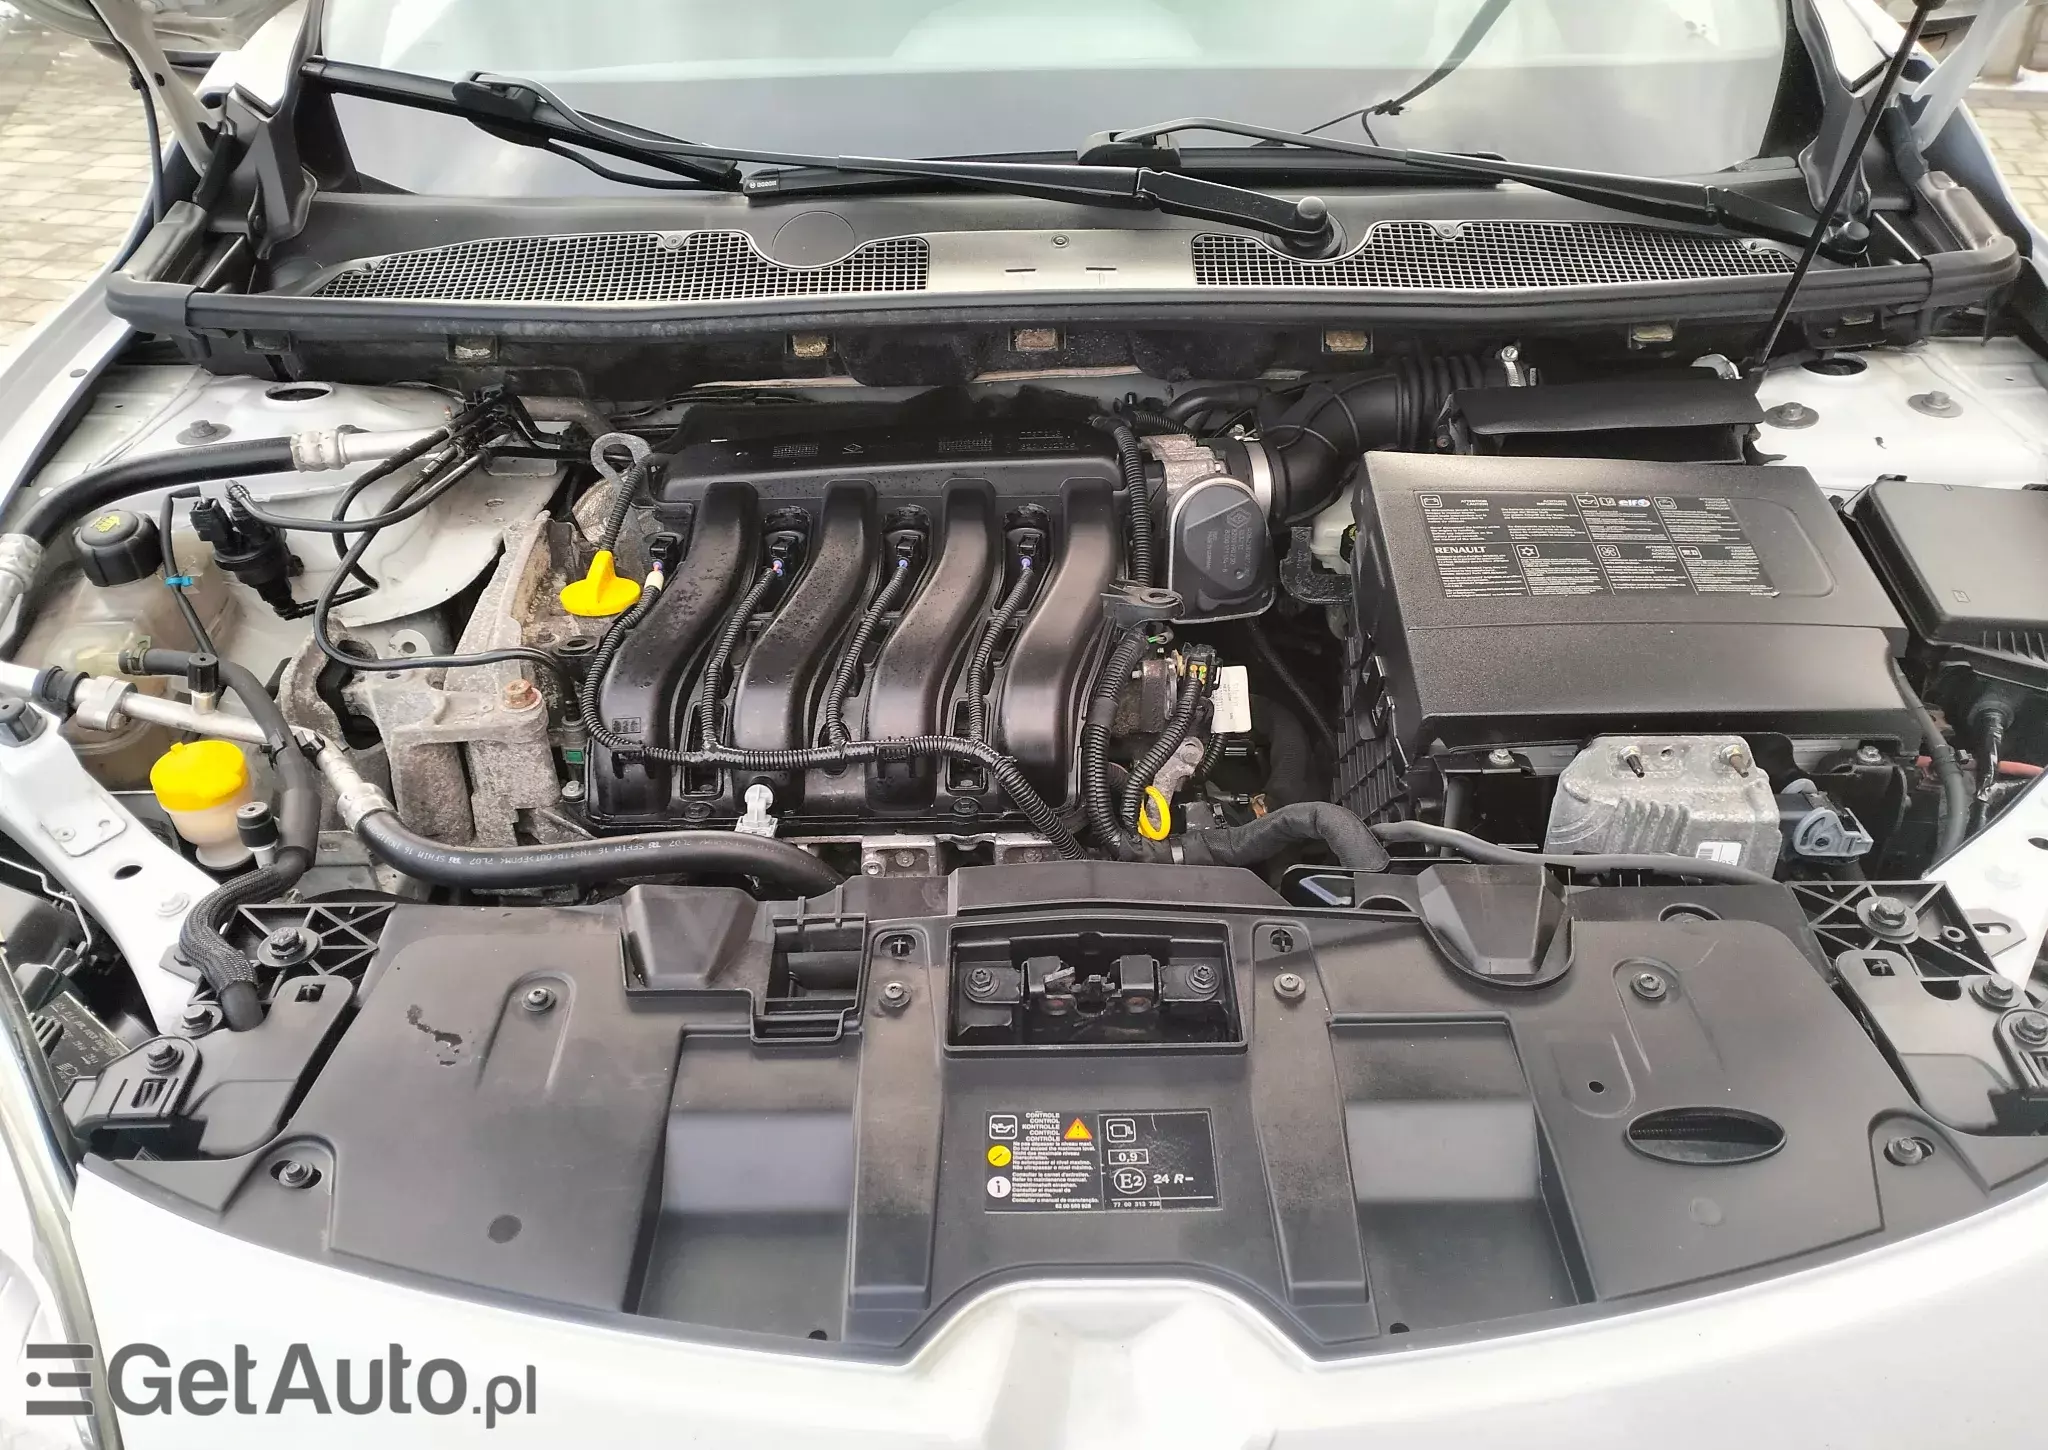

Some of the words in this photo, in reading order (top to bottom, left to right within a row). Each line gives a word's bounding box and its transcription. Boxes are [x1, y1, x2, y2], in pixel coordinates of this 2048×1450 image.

[1433, 546, 1486, 554] RENAULT
[1118, 1152, 1138, 1163] 0,9
[1119, 1173, 1144, 1189] E2
[1152, 1173, 1171, 1184] 24
